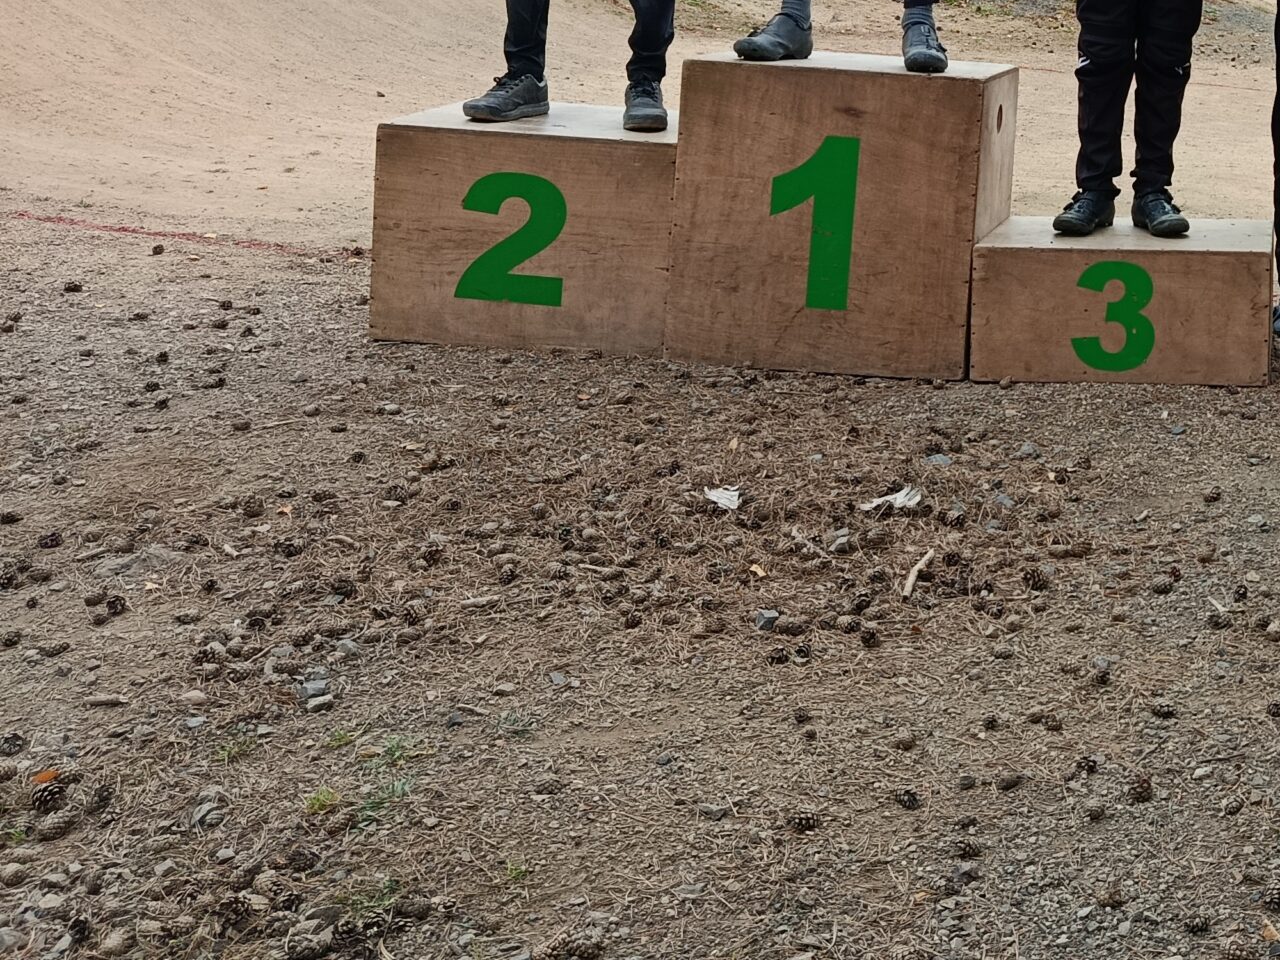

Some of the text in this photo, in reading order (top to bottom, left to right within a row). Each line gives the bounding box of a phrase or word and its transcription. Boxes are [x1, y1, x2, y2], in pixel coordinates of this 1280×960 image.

[453, 171, 567, 308] 2
[769, 135, 861, 311] 1
[1070, 260, 1155, 372] 3
